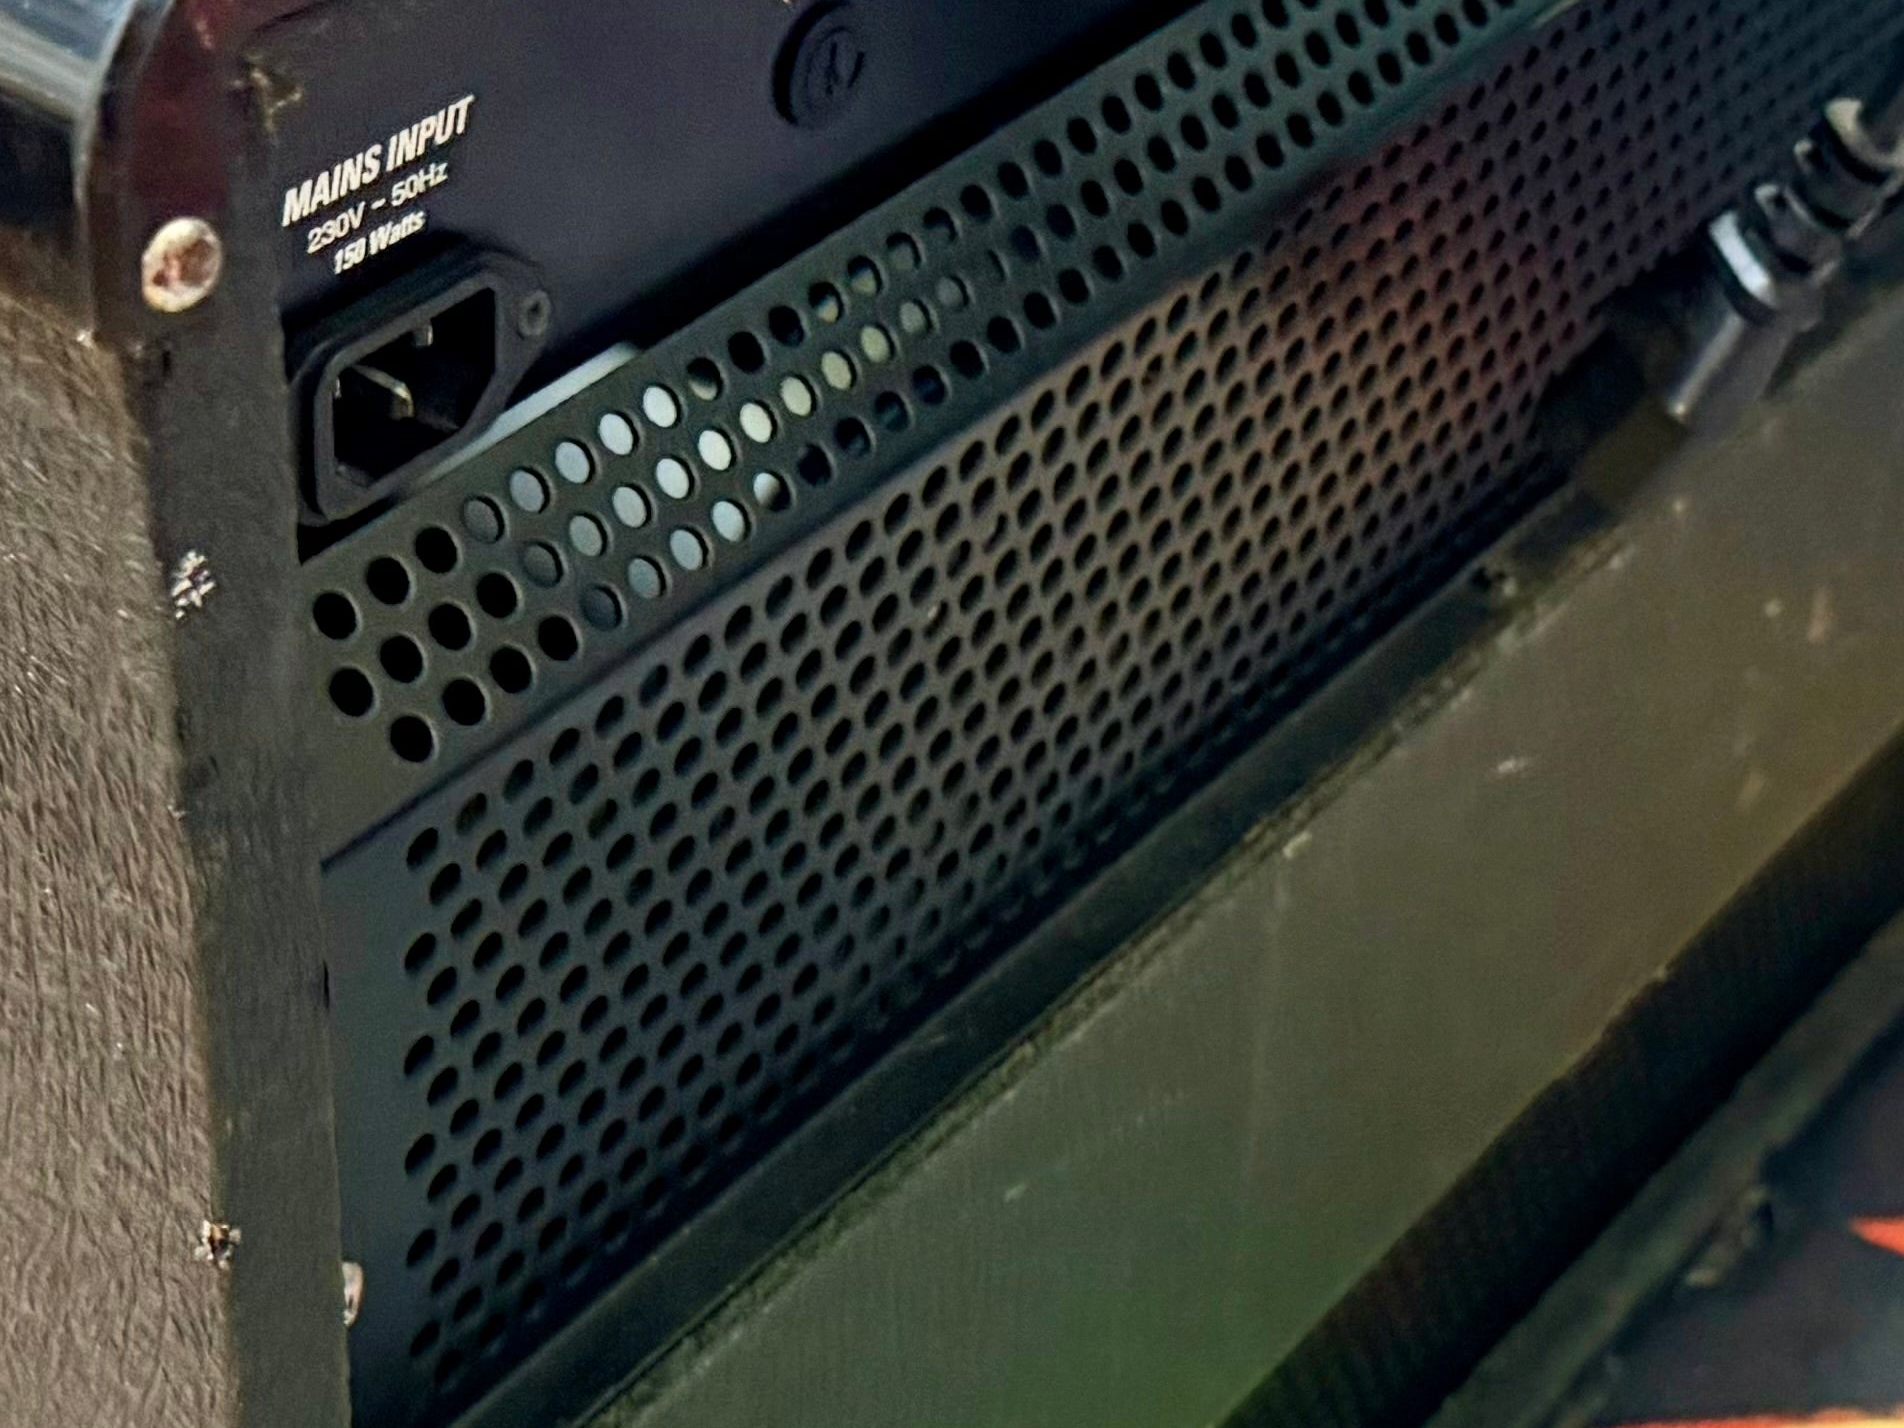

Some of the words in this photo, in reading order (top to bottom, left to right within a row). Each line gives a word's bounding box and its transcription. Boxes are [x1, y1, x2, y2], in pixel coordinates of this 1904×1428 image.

[282, 143, 382, 227] MAINS
[385, 94, 476, 172] INPUT
[307, 201, 365, 254] 230V
[391, 162, 449, 207] 50Hz
[334, 238, 366, 275] 150
[369, 210, 427, 255] Watts
